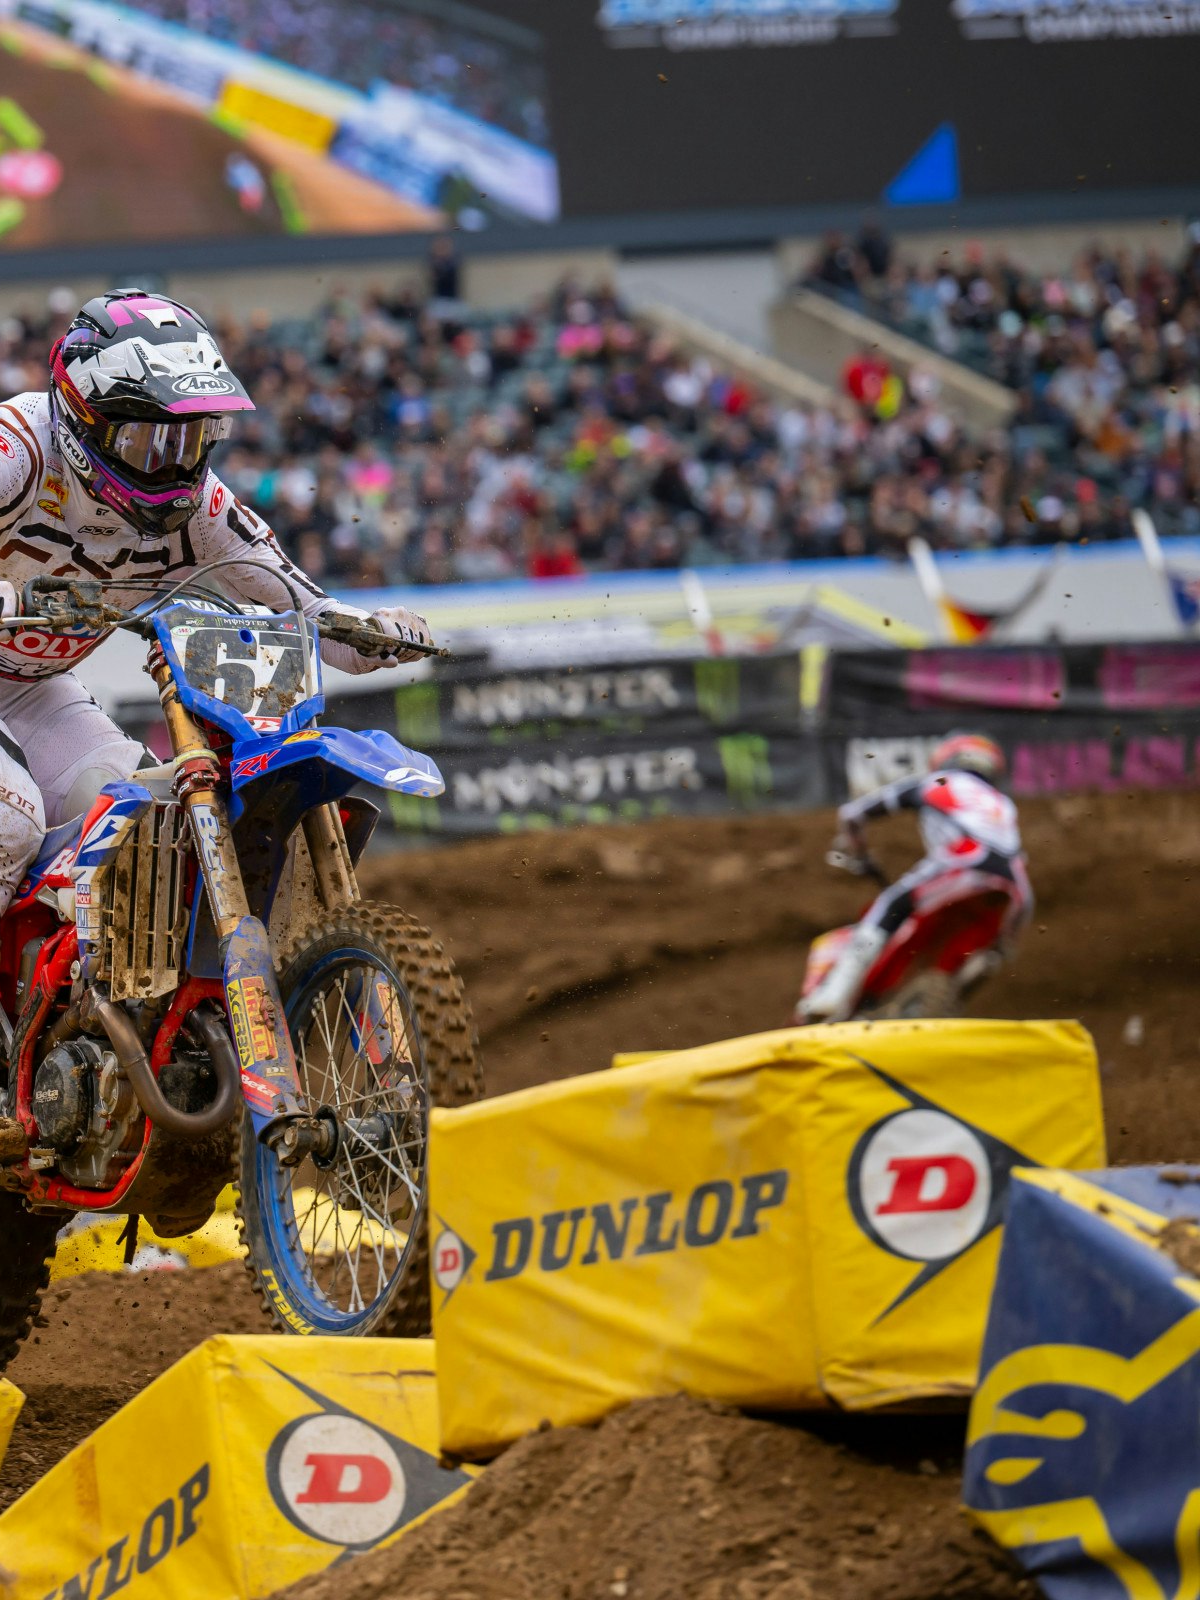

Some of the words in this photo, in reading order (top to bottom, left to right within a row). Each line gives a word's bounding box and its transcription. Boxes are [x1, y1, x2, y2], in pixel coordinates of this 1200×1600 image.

[188, 375, 229, 388] Arai
[96, 508, 110, 516] 67
[185, 629, 314, 717] 67
[876, 1154, 977, 1215] D
[484, 1169, 789, 1282] DUNLOP
[262, 1269, 315, 1336] PIRELLI
[295, 1453, 392, 1504] D
[43, 1462, 211, 1600] NLOP
